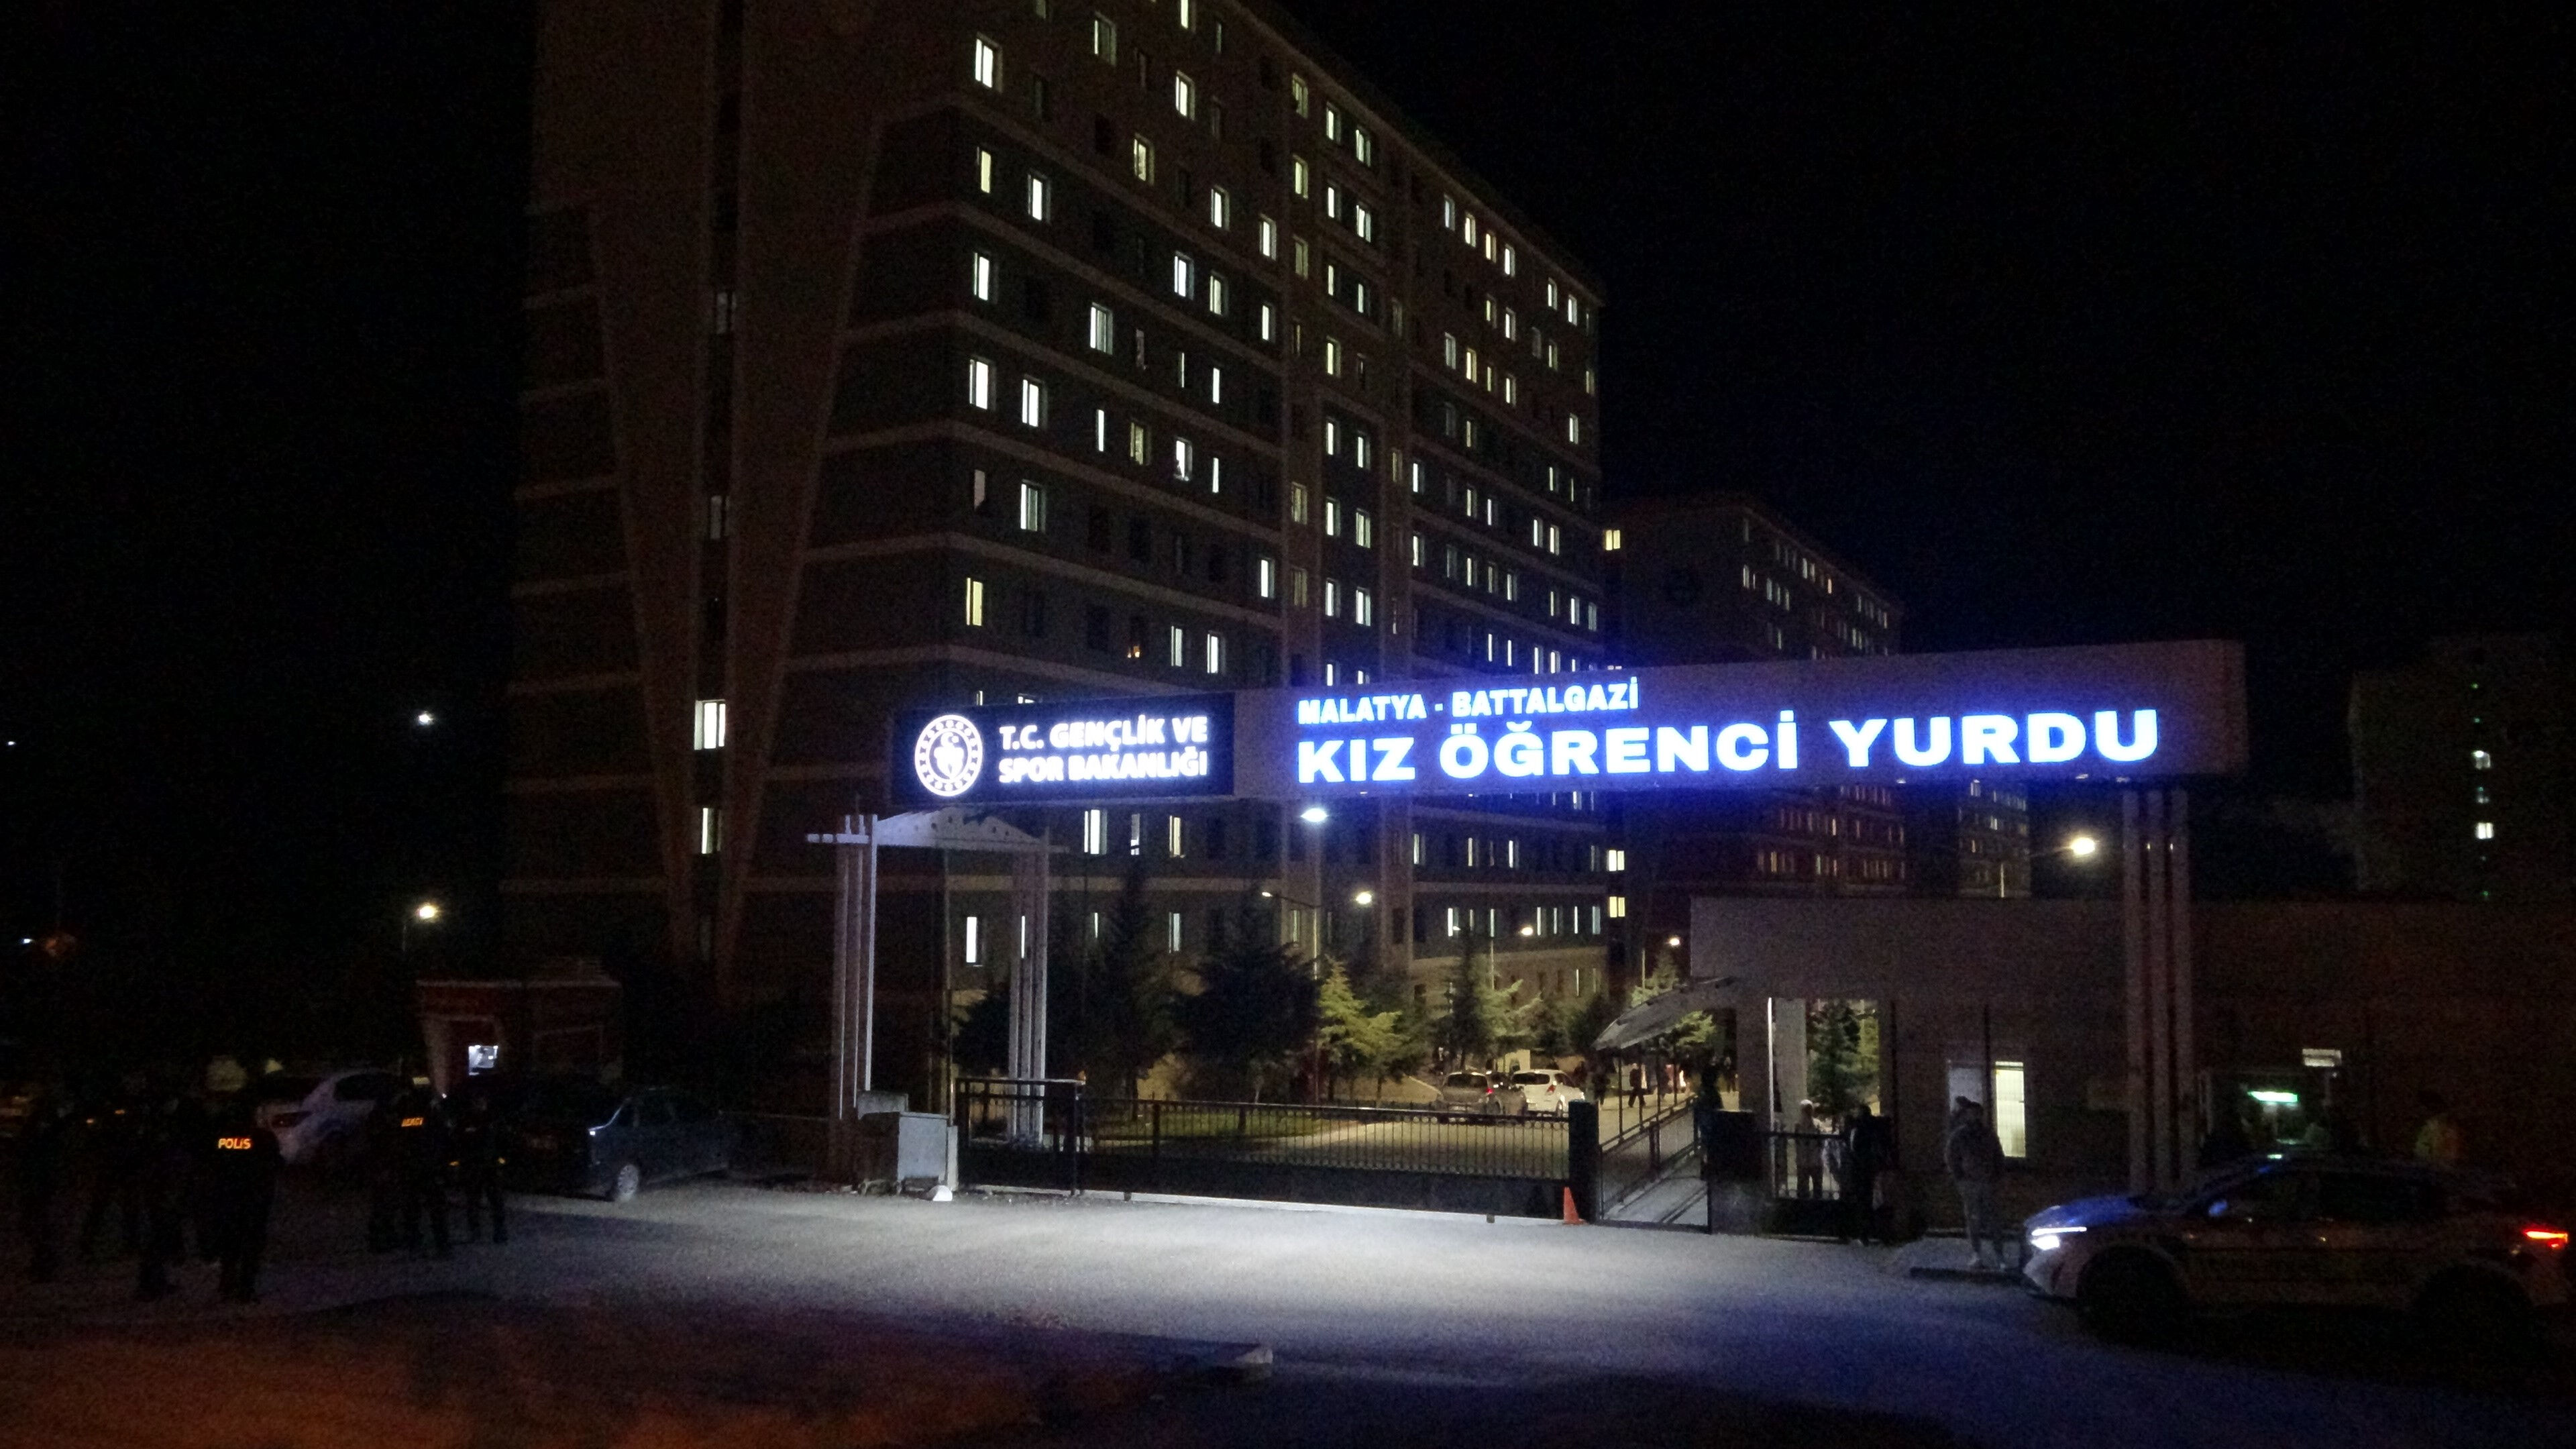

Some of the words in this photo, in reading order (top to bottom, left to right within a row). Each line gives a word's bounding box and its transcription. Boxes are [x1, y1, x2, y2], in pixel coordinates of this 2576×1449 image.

[1297, 694, 1428, 724] MALATYA
[1451, 676, 1639, 717] BATTALGAZİ
[999, 724, 1044, 750] T.C.
[1049, 714, 1165, 752] GENÇLİK
[1171, 716, 1208, 743] VE
[1297, 737, 1416, 784] KIZ
[1439, 710, 1799, 779] ÖĞRENCİ
[1829, 710, 2158, 767] YURDU
[998, 755, 1065, 783] SPOR
[1068, 746, 1208, 781] BAKANLIĞI
